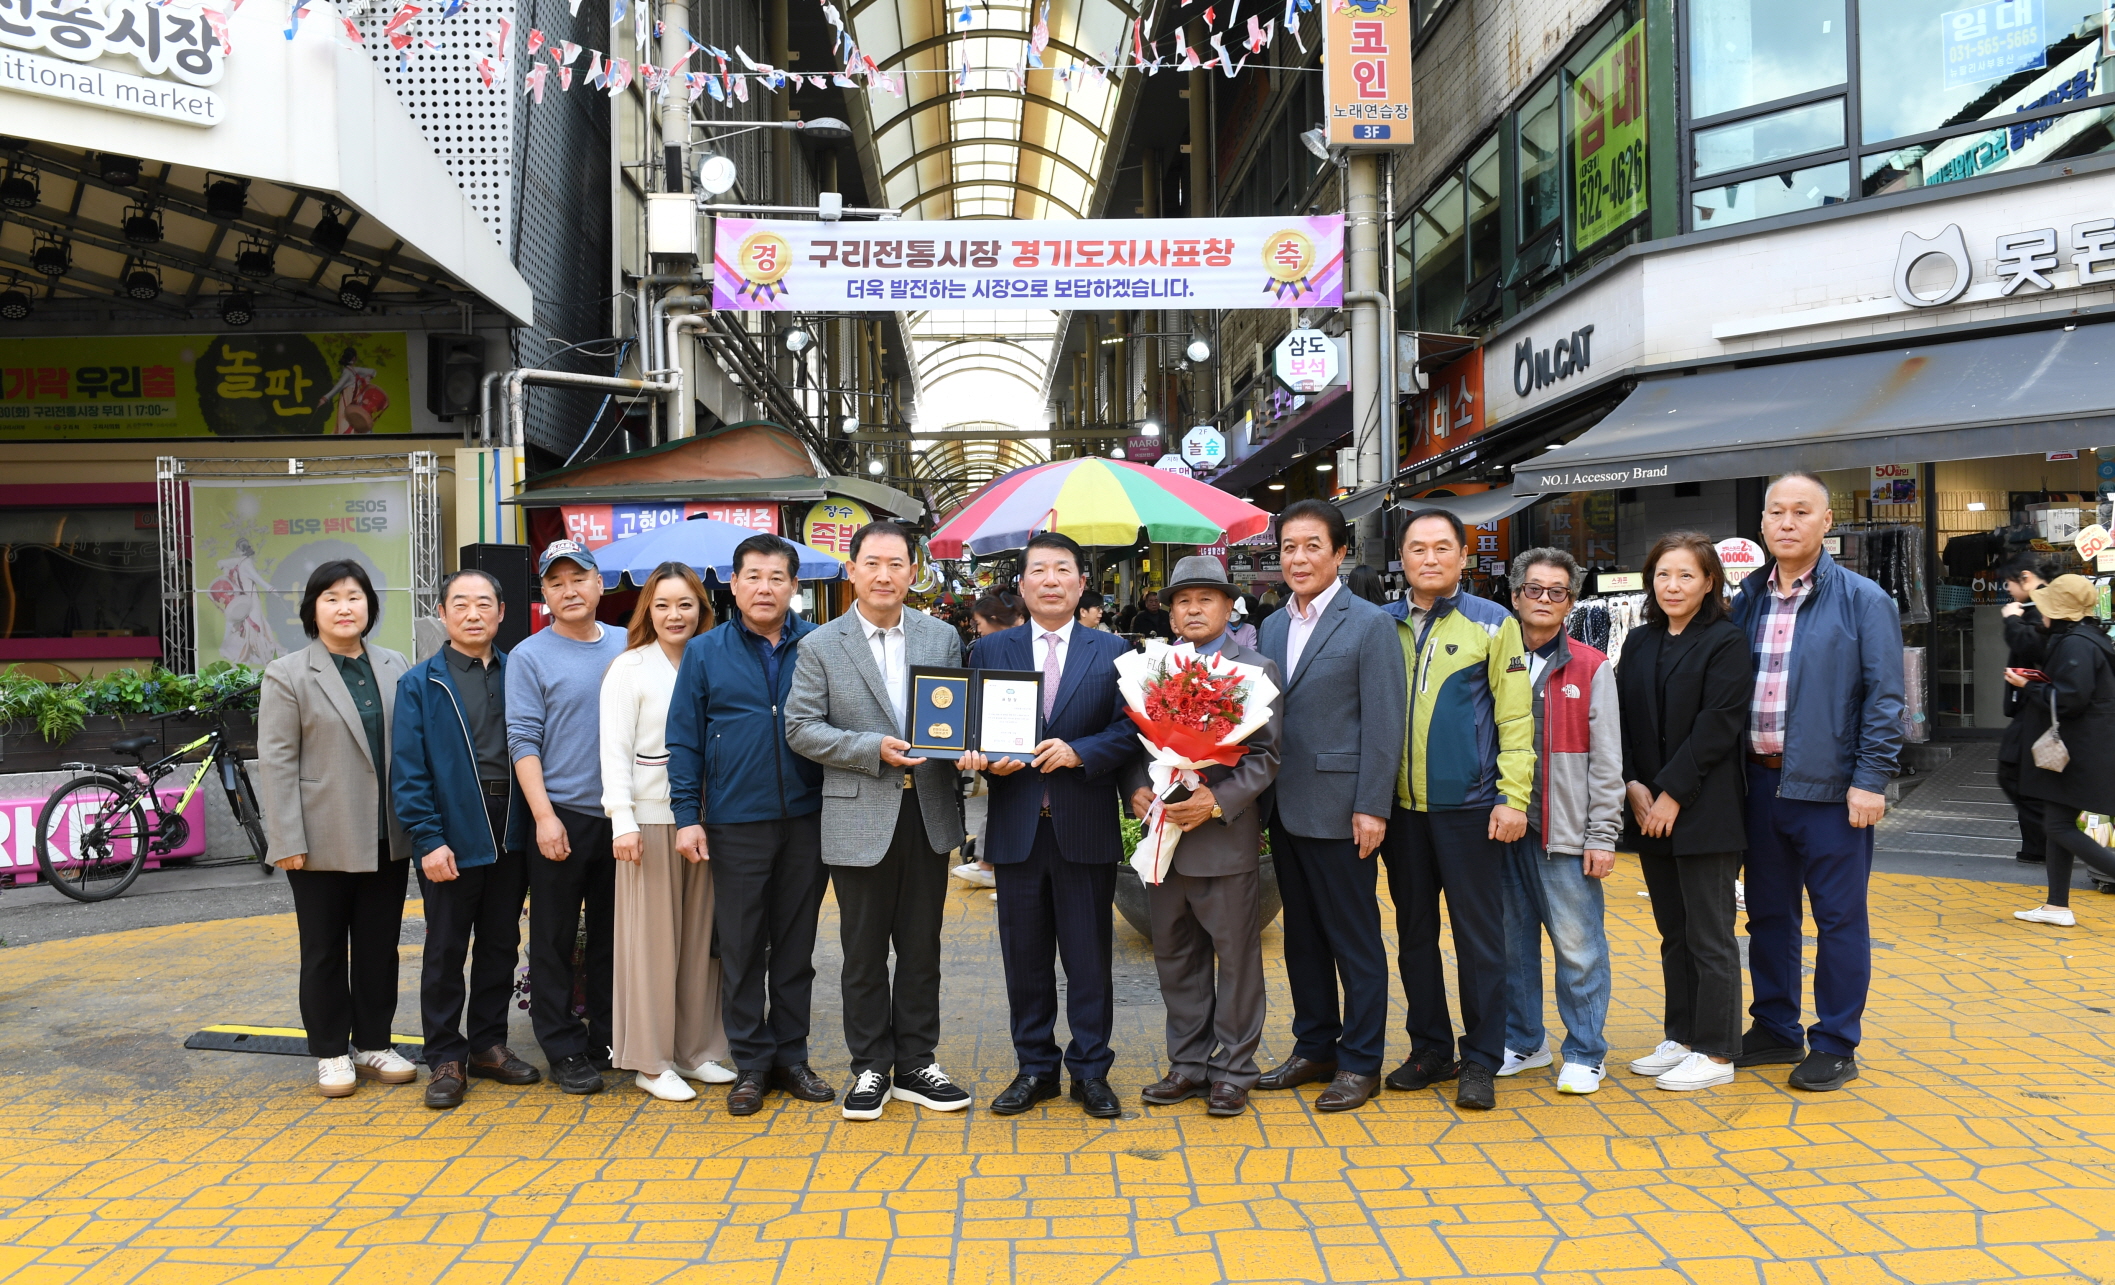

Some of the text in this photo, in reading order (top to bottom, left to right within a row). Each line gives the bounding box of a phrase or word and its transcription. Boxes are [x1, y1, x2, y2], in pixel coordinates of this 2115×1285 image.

[1952, 0, 2032, 41] 임대
[1950, 26, 2038, 63] 031-565-5665
[1350, 21, 1389, 100] 코인
[4, 54, 214, 118] itional market
[1578, 32, 1641, 161] 임대
[1333, 104, 1409, 119] 노래연습장
[1363, 125, 1380, 138] 3F
[1579, 154, 1599, 179] (031)
[1580, 138, 1643, 230] 522-4626
[751, 244, 777, 273] 경
[808, 238, 1235, 269] 구리전통시장 경기도지사표창
[1274, 240, 1303, 271] 축
[847, 277, 1195, 300] 더욱 발전하는 시장으로 보답하겠습니다.
[1288, 336, 1326, 357] 삼도
[215, 344, 312, 417] 놀판
[1289, 357, 1326, 378] 보석
[0, 365, 176, 400] 가락 우리춤
[34, 405, 99, 418] 구리전통시장
[102, 405, 124, 417] 무대
[1129, 439, 1159, 448] MARO
[1187, 437, 1220, 456] 놀숲
[1541, 464, 1668, 486] NO.1 Accessory Brand
[823, 505, 853, 519] 장수
